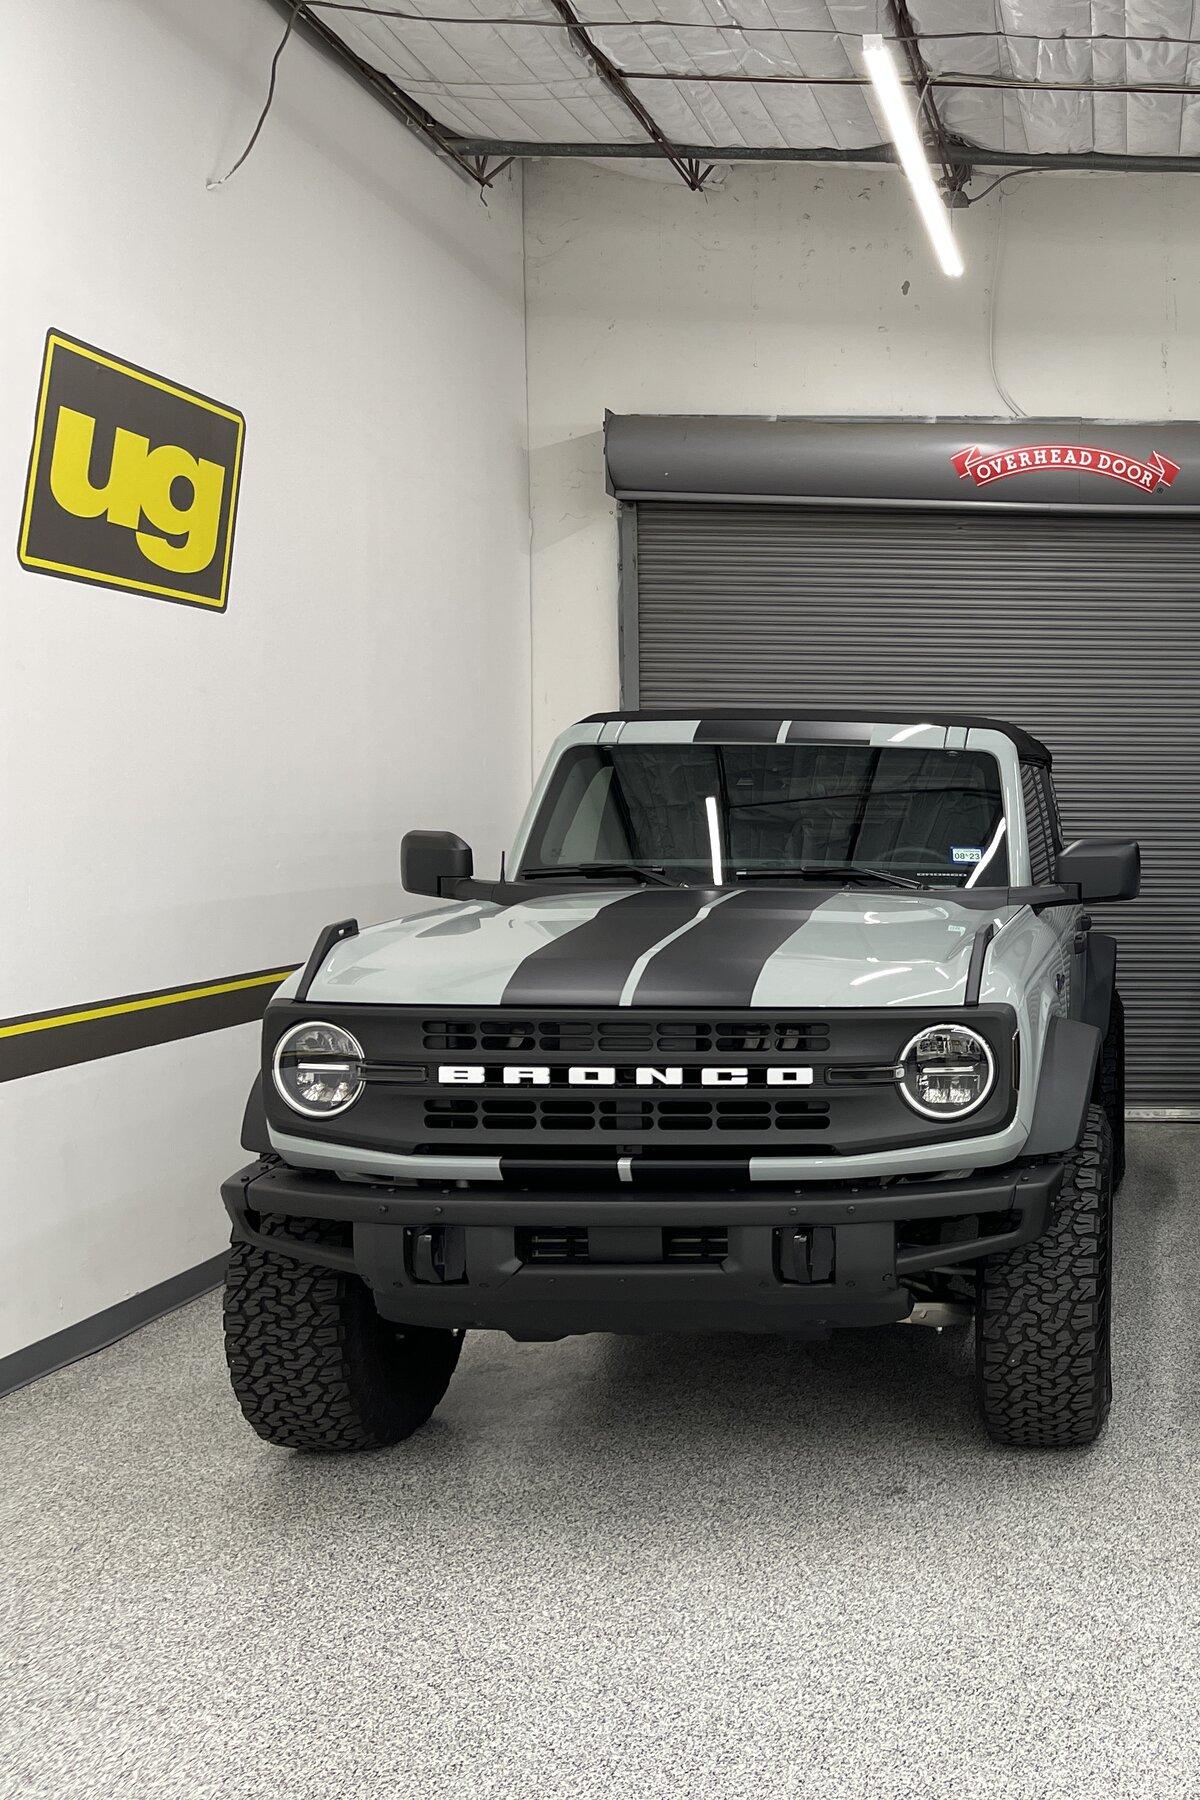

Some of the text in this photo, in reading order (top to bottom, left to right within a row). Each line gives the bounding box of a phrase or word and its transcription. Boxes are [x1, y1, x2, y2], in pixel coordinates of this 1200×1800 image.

[976, 449, 1153, 487] OVERHEAD DOOR
[50, 405, 225, 573] ug
[438, 1065, 814, 1085] BRONCO
